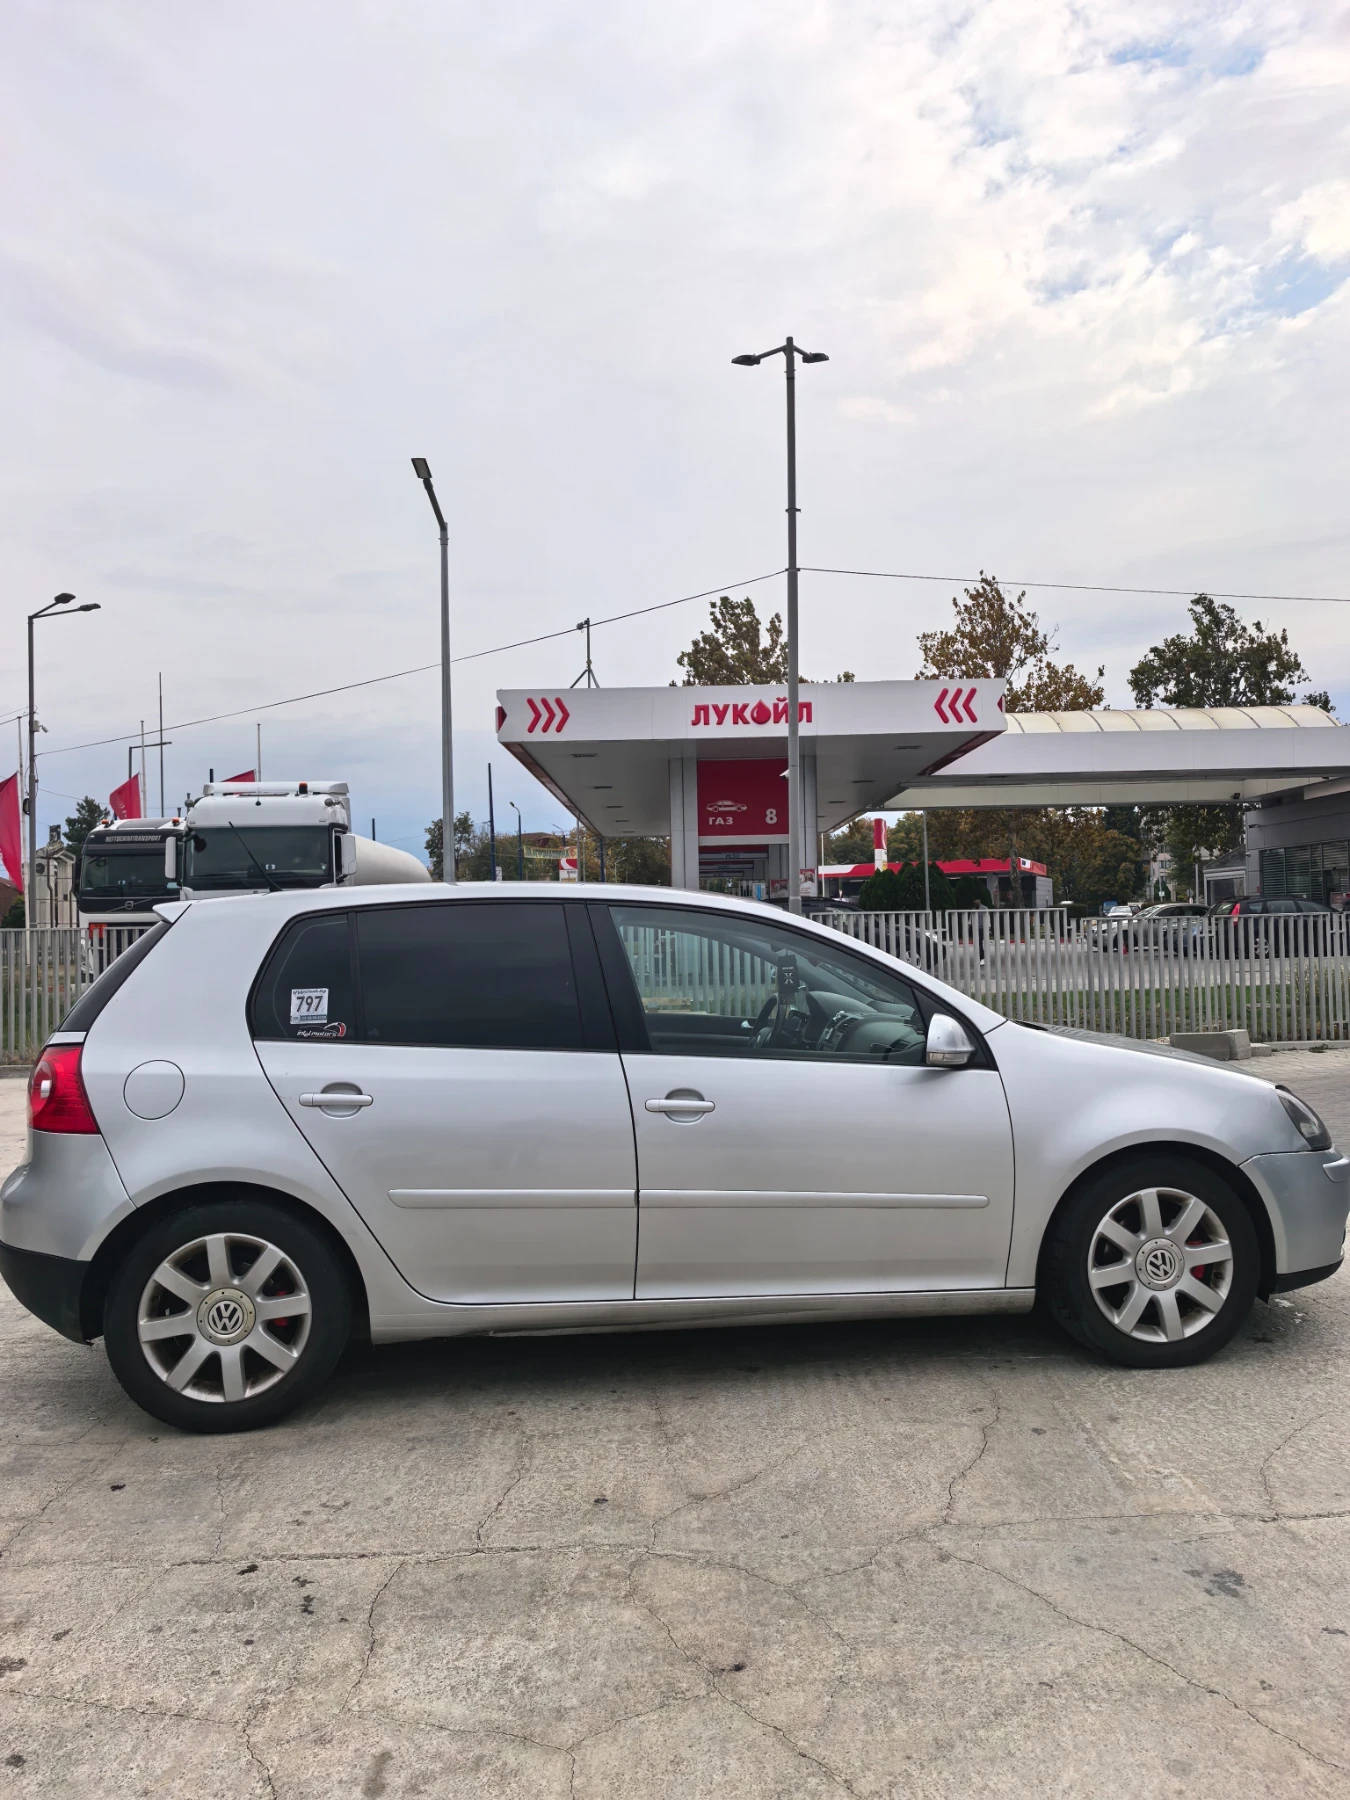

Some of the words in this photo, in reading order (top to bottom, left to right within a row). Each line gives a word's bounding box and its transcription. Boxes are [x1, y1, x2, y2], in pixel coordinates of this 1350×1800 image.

[708, 816, 734, 826] ГАЗ
[765, 808, 778, 825] 8
[296, 996, 323, 1012] 797
